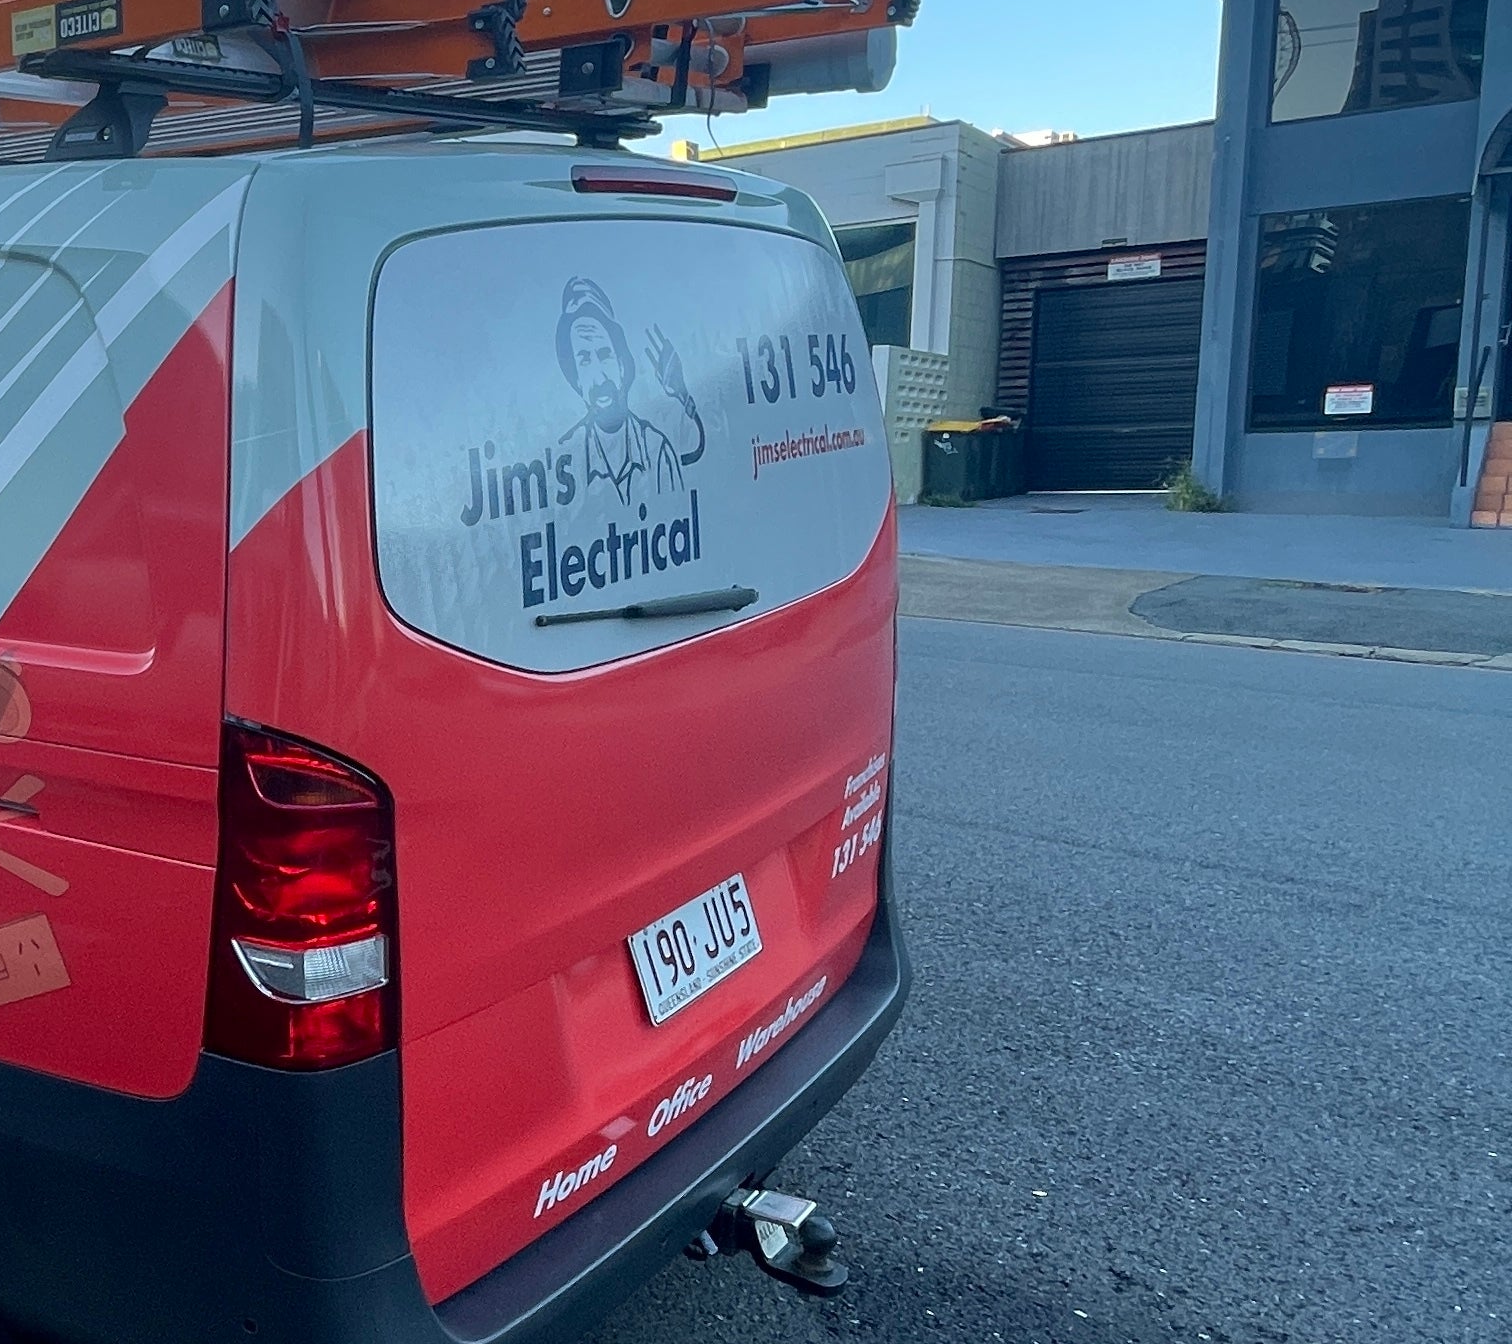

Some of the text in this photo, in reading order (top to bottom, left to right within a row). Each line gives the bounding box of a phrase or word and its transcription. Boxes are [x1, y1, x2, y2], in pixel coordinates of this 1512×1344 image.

[60, 11, 99, 38] CITECO
[736, 333, 856, 404] 131 546
[460, 442, 575, 527] Jim's
[752, 423, 865, 480] jimselectrical.com.au
[520, 489, 702, 609] Electrical
[831, 833, 858, 879] 131
[533, 976, 828, 1218] Home Office Warehouse
